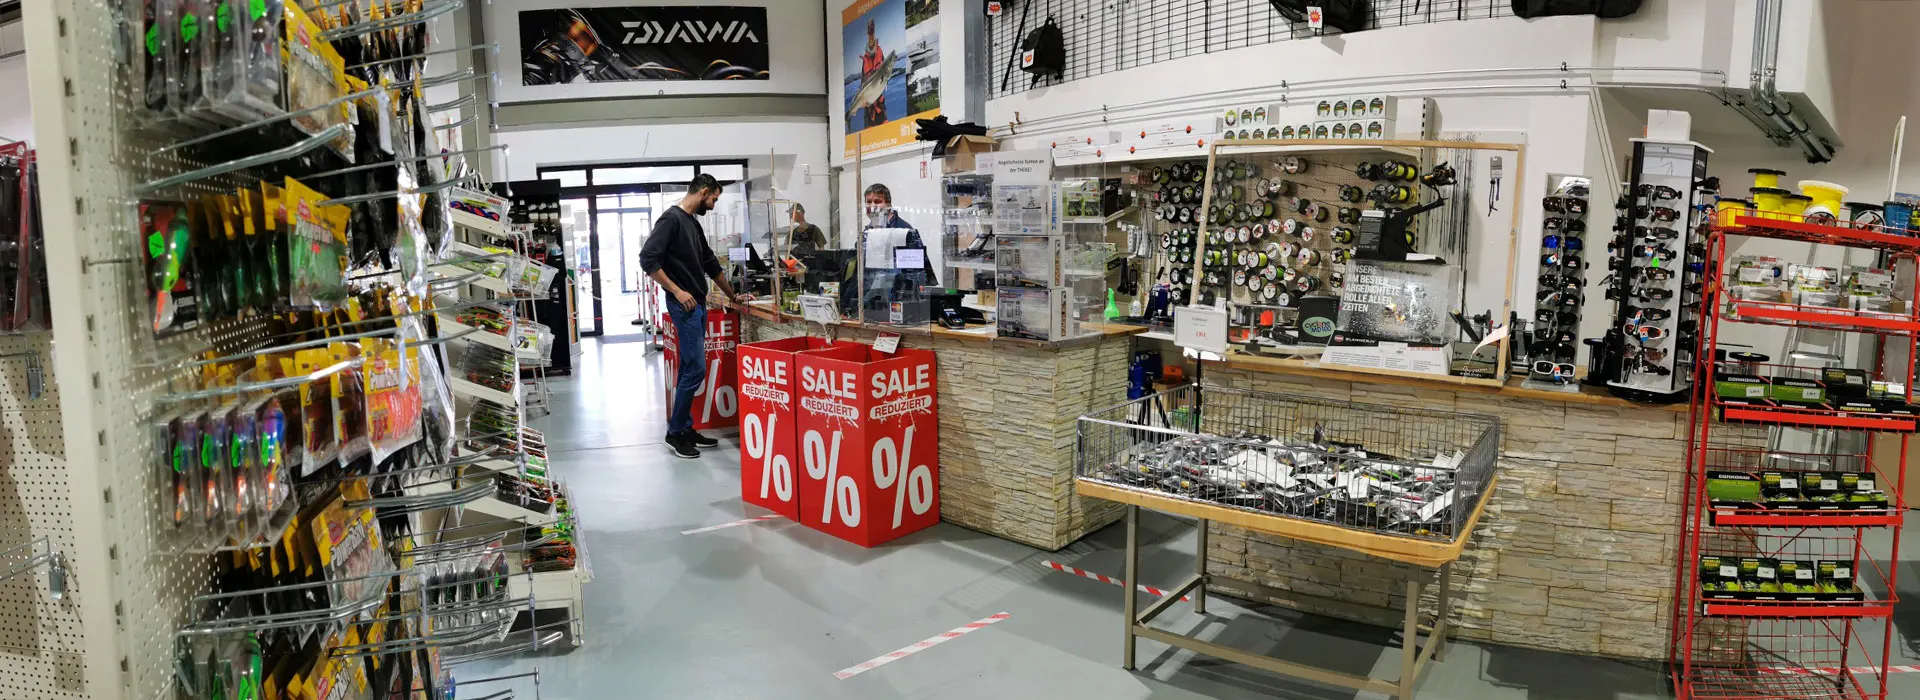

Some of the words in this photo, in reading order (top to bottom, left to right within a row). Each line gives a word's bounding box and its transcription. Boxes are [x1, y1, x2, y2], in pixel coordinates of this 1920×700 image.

[621, 20, 759, 44] DAIWA
[1349, 264, 1378, 274] UNSERE
[1347, 274, 1360, 283] AM
[1344, 292, 1368, 303] ROLLE
[1368, 294, 1392, 305] ALLER
[1345, 283, 1401, 297] ABGEDICHTETE
[1342, 302, 1369, 312] ZEITEN
[705, 320, 733, 338] LE
[703, 341, 730, 350] UZIERT
[742, 355, 788, 386] SALE
[801, 365, 857, 400] SALE
[871, 363, 930, 399] SALE
[745, 385, 785, 402] REDUZIERT
[805, 399, 853, 417] REDUZIERT
[875, 397, 927, 418] REDUZIERT
